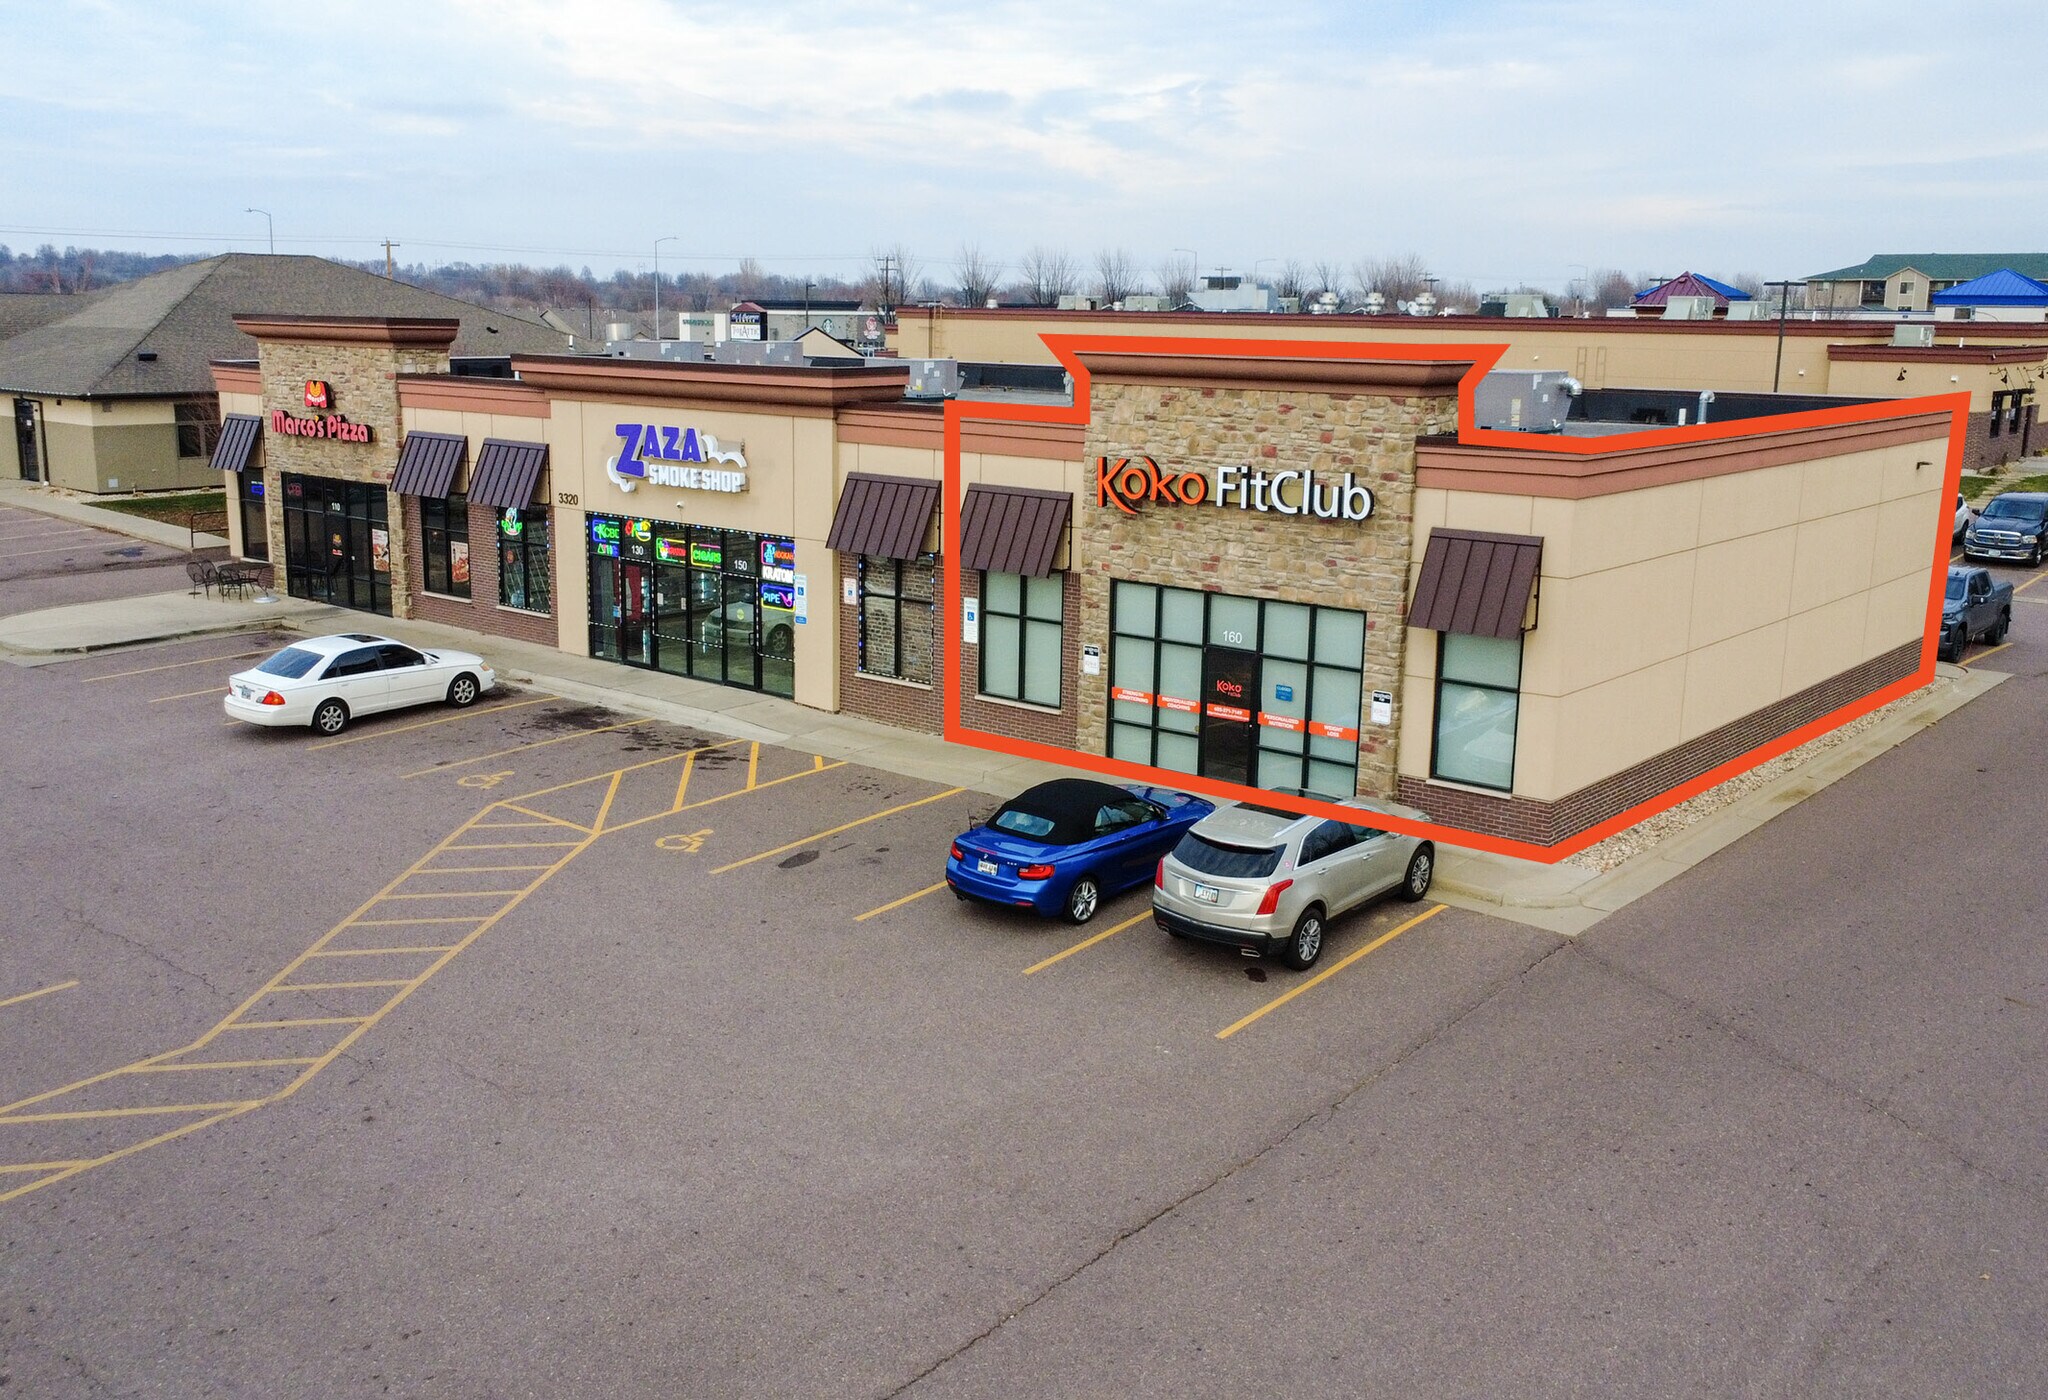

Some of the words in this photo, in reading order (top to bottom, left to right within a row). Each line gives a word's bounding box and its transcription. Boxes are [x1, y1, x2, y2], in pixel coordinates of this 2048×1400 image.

[271, 409, 325, 438] Marco's
[326, 414, 369, 443] Pizza
[615, 423, 704, 478] ZAZA
[648, 463, 701, 489] SMOKE
[701, 469, 746, 493] SHOP
[1097, 456, 1208, 514] Koko
[1216, 465, 1375, 521] FitClub
[558, 493, 579, 505] 3320
[331, 502, 341, 512] 110
[631, 544, 644, 556] 130
[734, 559, 748, 571] 150
[762, 565, 794, 584] KRATOM
[763, 592, 781, 604] PIPE
[1223, 630, 1243, 644] 160
[1216, 679, 1242, 694] Koko
[1323, 724, 1344, 733] WEIGHT
[1326, 730, 1340, 738] LOSS
